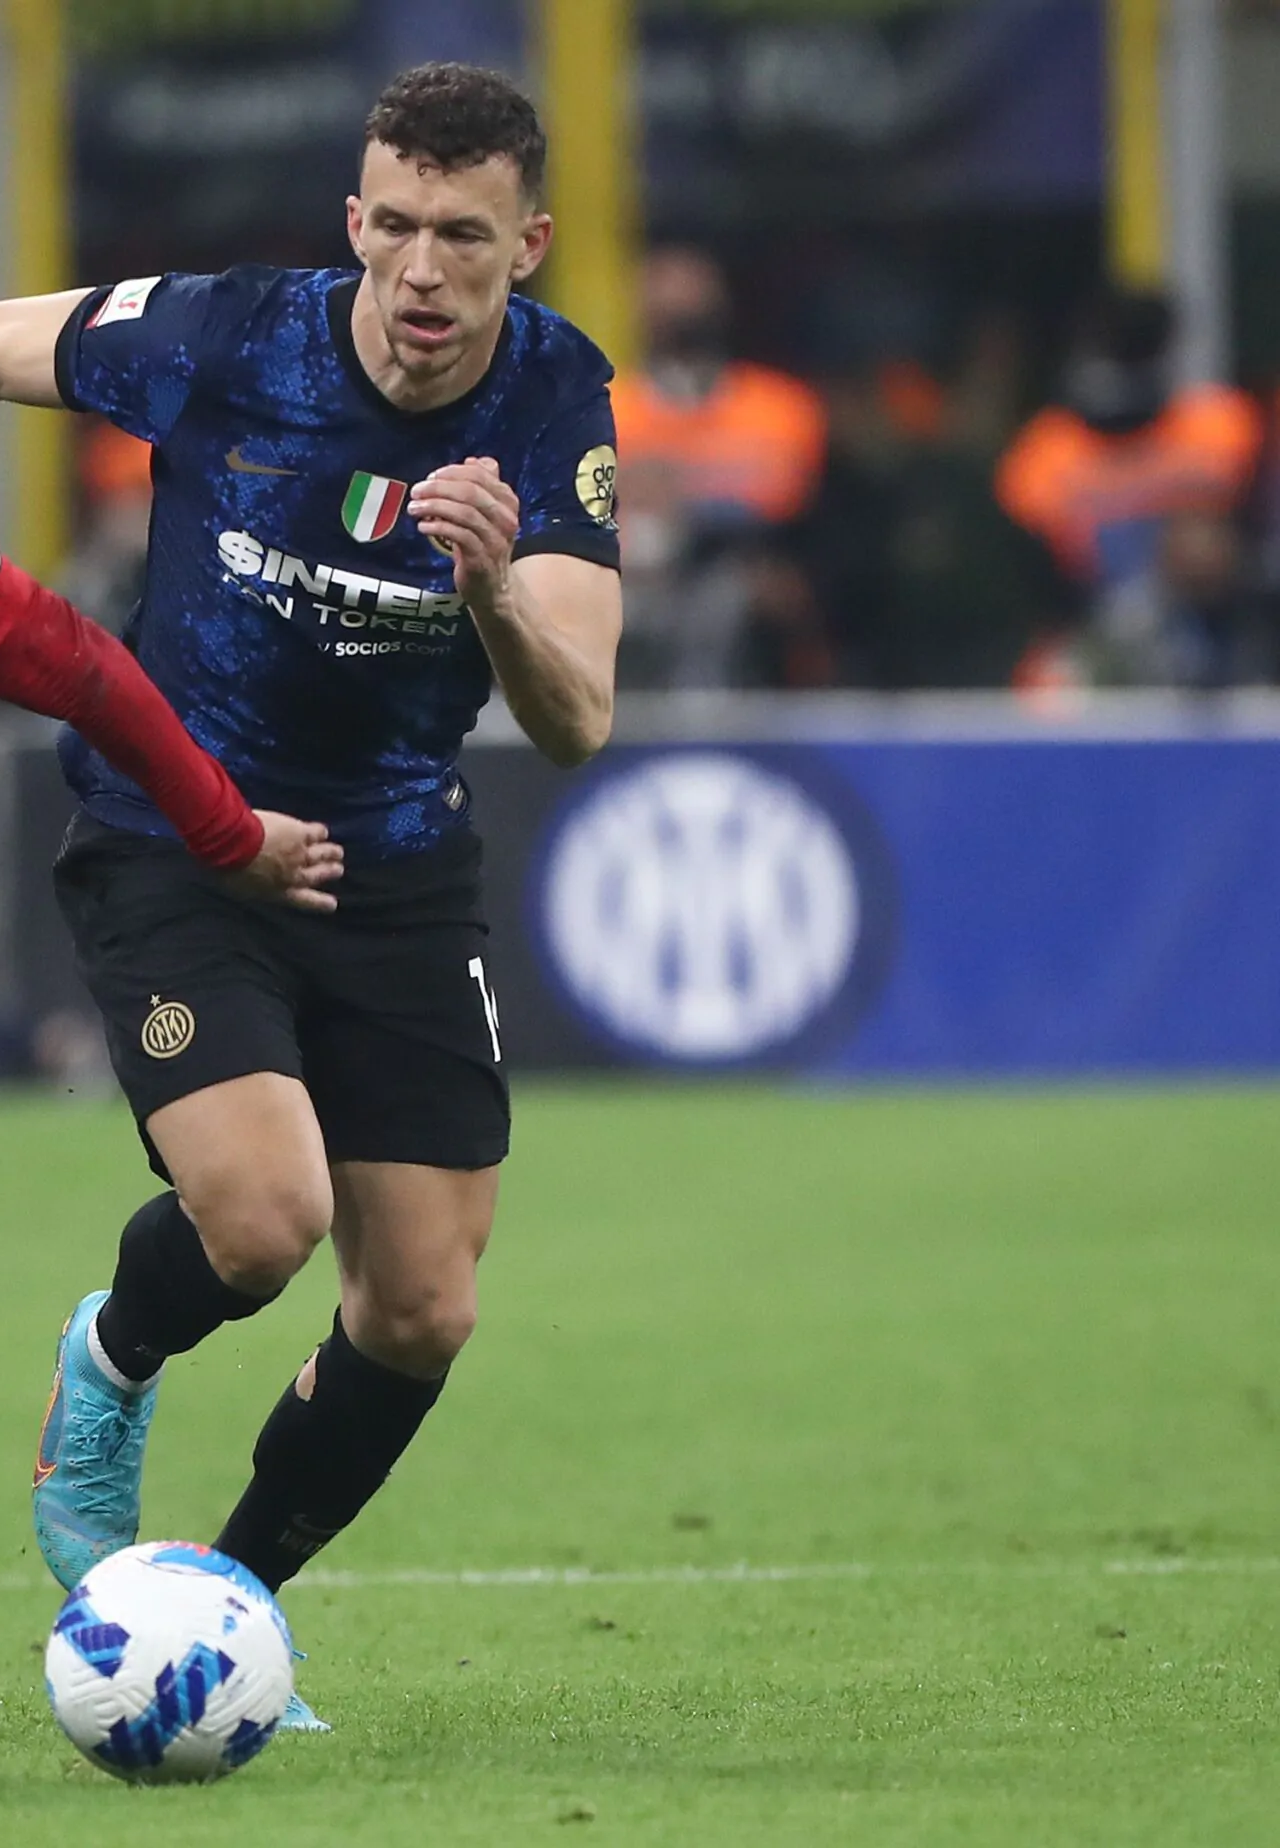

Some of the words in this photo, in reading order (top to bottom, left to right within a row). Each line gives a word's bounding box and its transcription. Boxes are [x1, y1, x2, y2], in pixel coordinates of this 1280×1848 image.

[217, 529, 465, 619] $INTER
[312, 602, 459, 637] TOKEN
[468, 956, 502, 1063] 1
